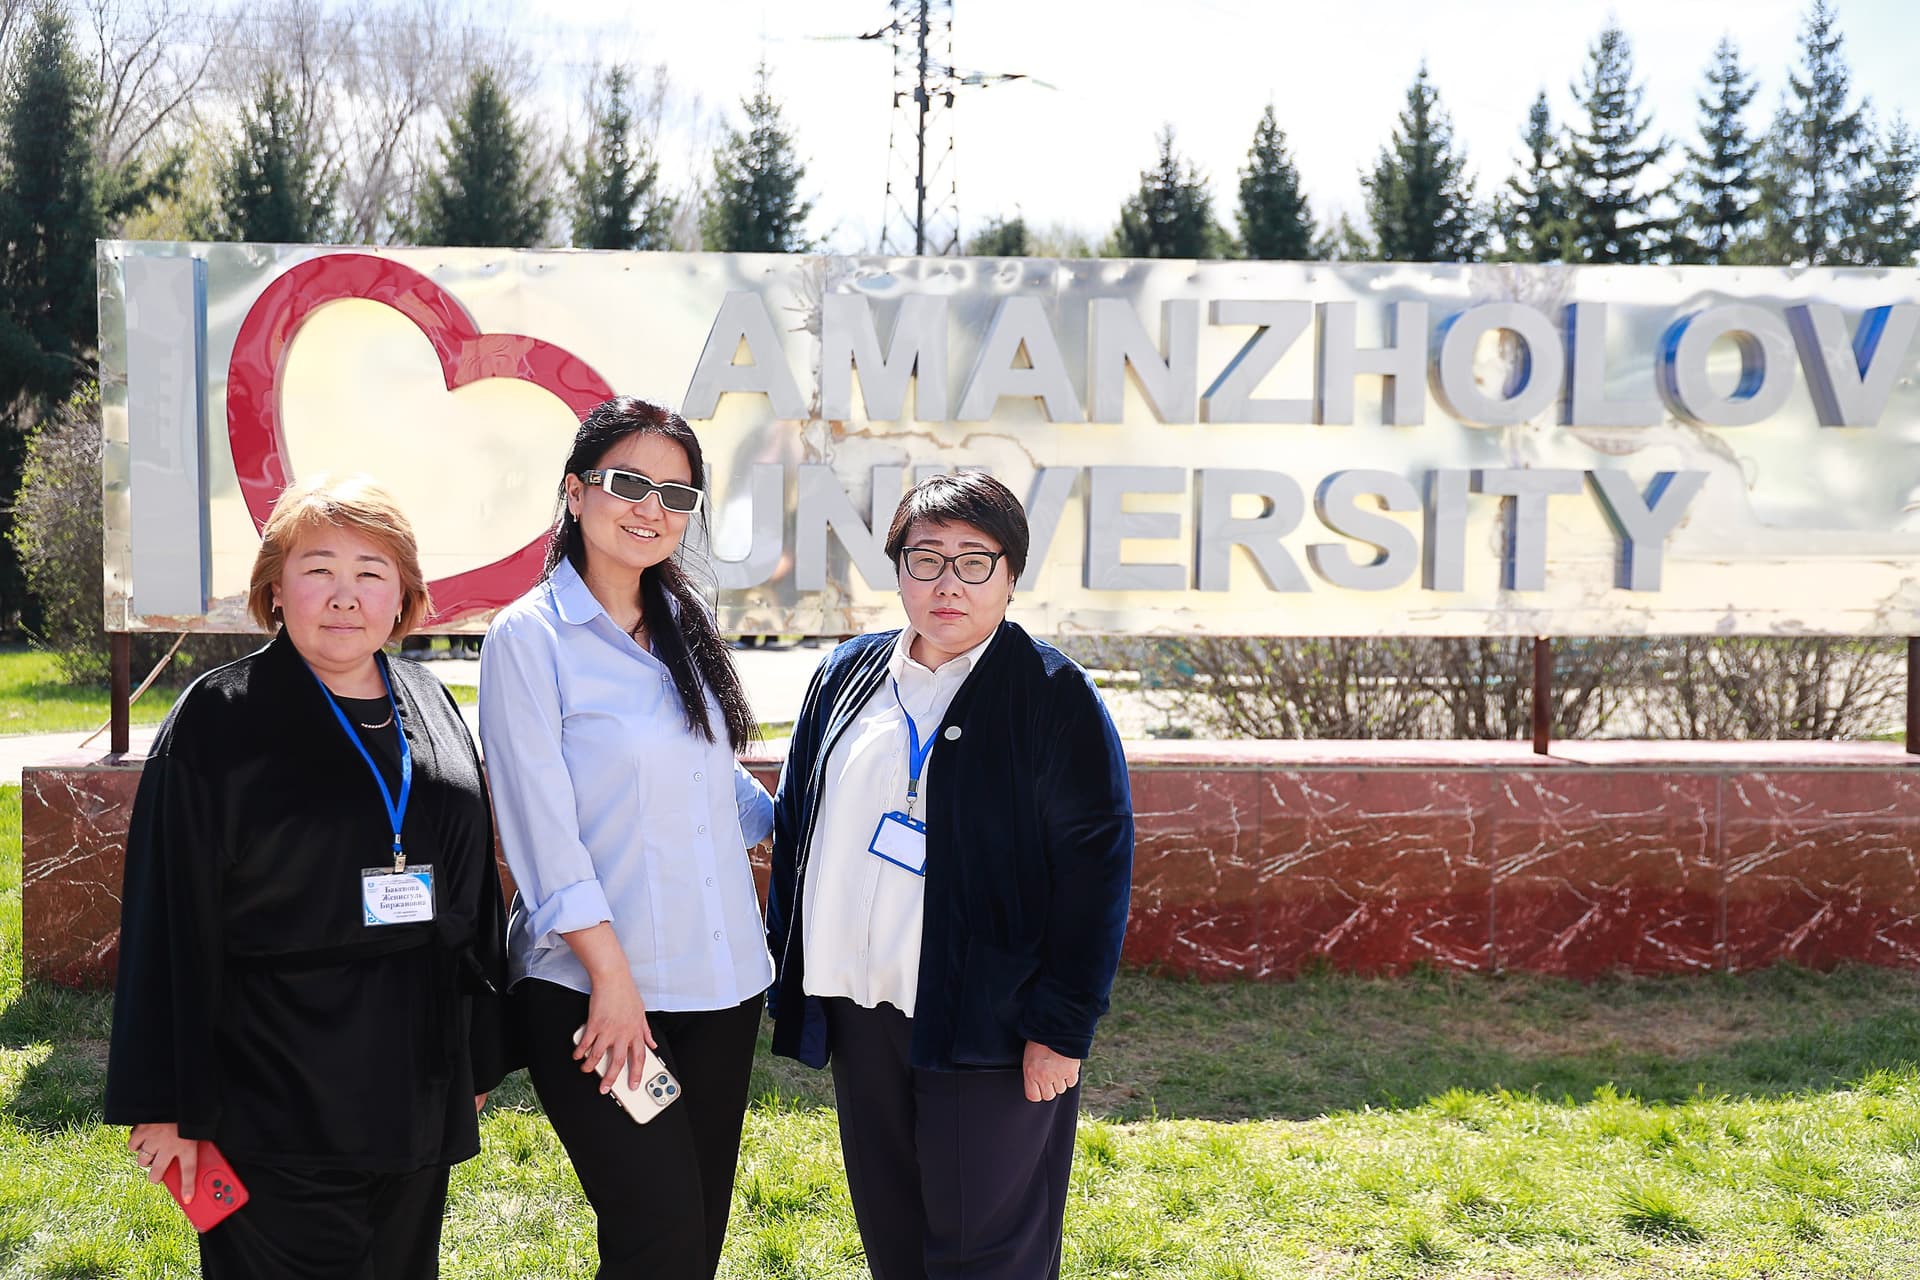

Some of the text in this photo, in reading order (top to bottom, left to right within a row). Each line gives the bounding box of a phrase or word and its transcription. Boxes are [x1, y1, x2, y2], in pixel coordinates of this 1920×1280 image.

[682, 290, 1920, 428] AMANZHOLOV
[124, 256, 208, 616] I
[688, 463, 1709, 592] UNVERSITY
